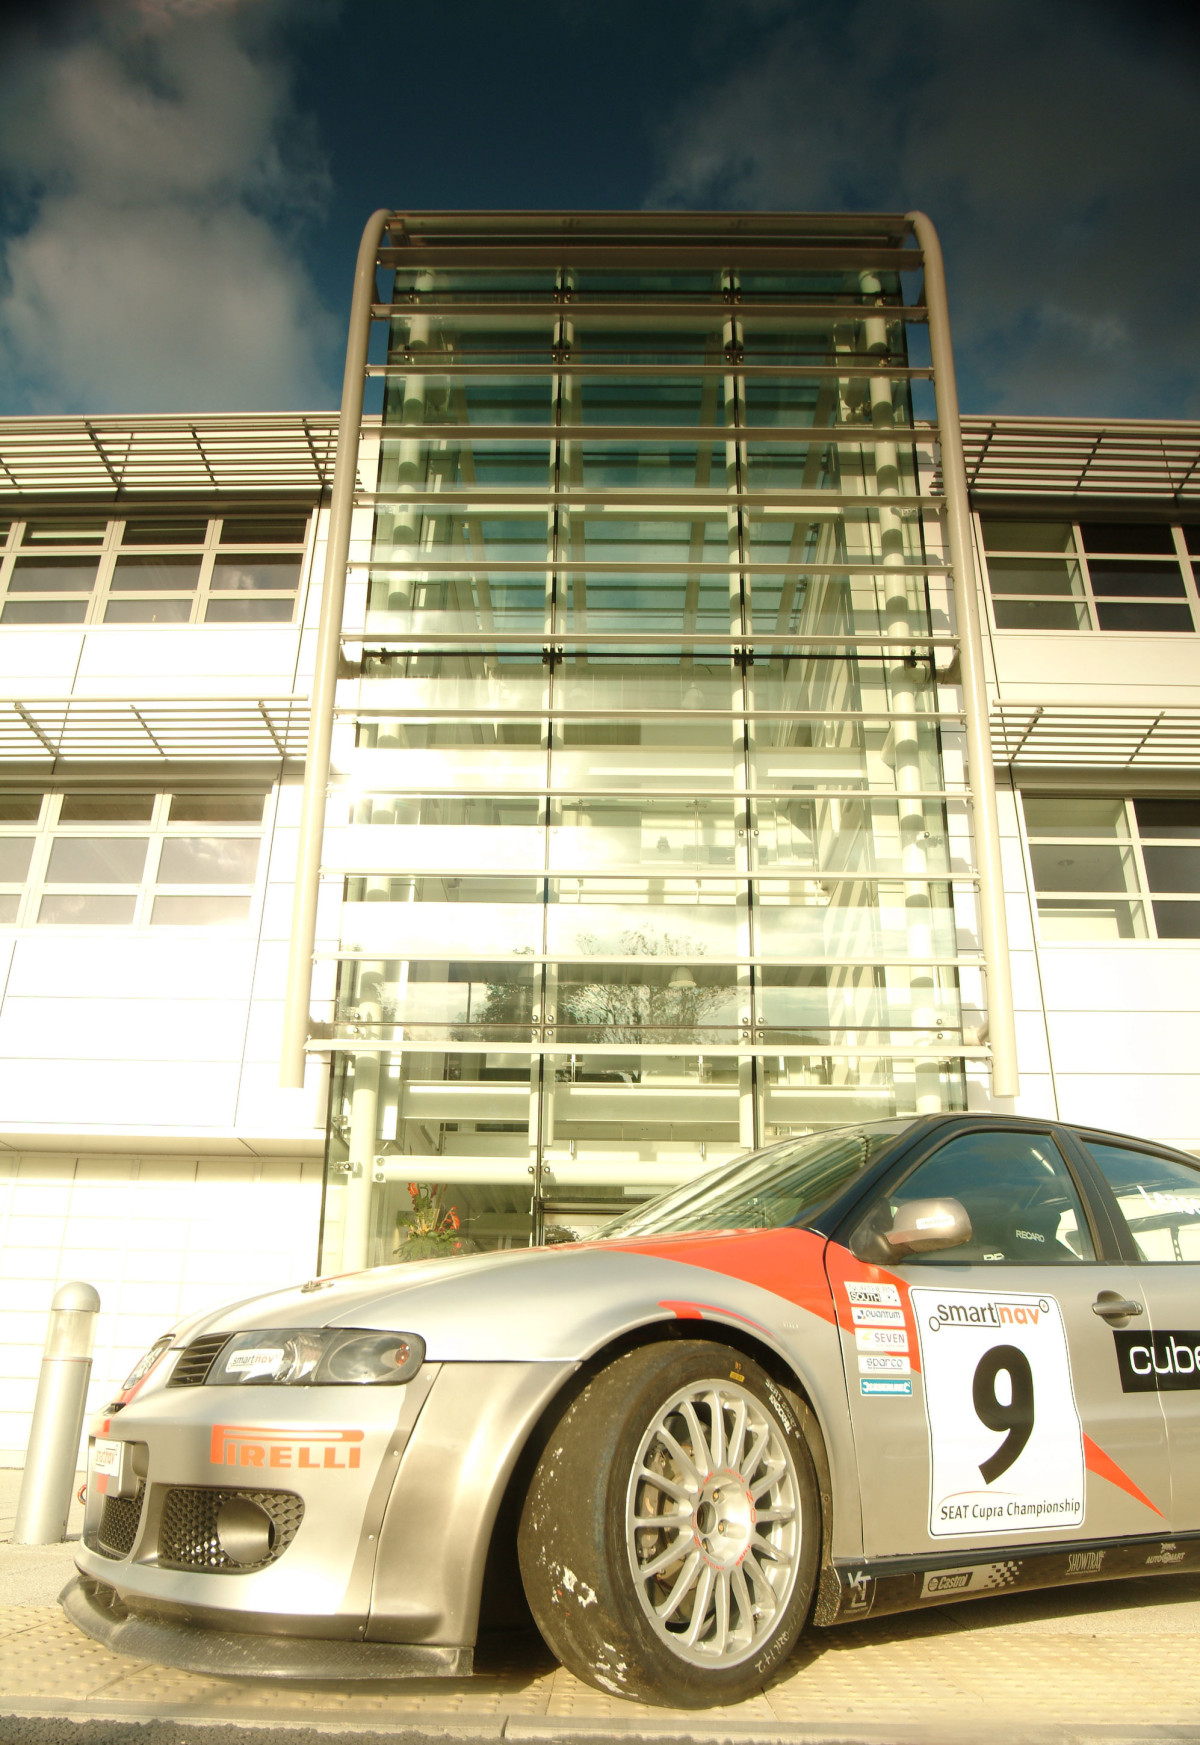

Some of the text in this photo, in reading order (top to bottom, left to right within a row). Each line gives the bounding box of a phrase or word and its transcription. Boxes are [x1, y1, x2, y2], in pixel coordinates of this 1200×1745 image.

[1016, 1230, 1045, 1243] RECARO
[936, 1302, 1040, 1325] smartnav
[874, 1332, 906, 1344] SEVEN
[866, 1357, 904, 1369] sparco
[1129, 1336, 1200, 1375] cub
[972, 1344, 1034, 1485] 9
[210, 1424, 365, 1469] PIRELLI
[941, 1498, 1080, 1521] SEAT Cupra Championship
[937, 1574, 969, 1591] Castrol
